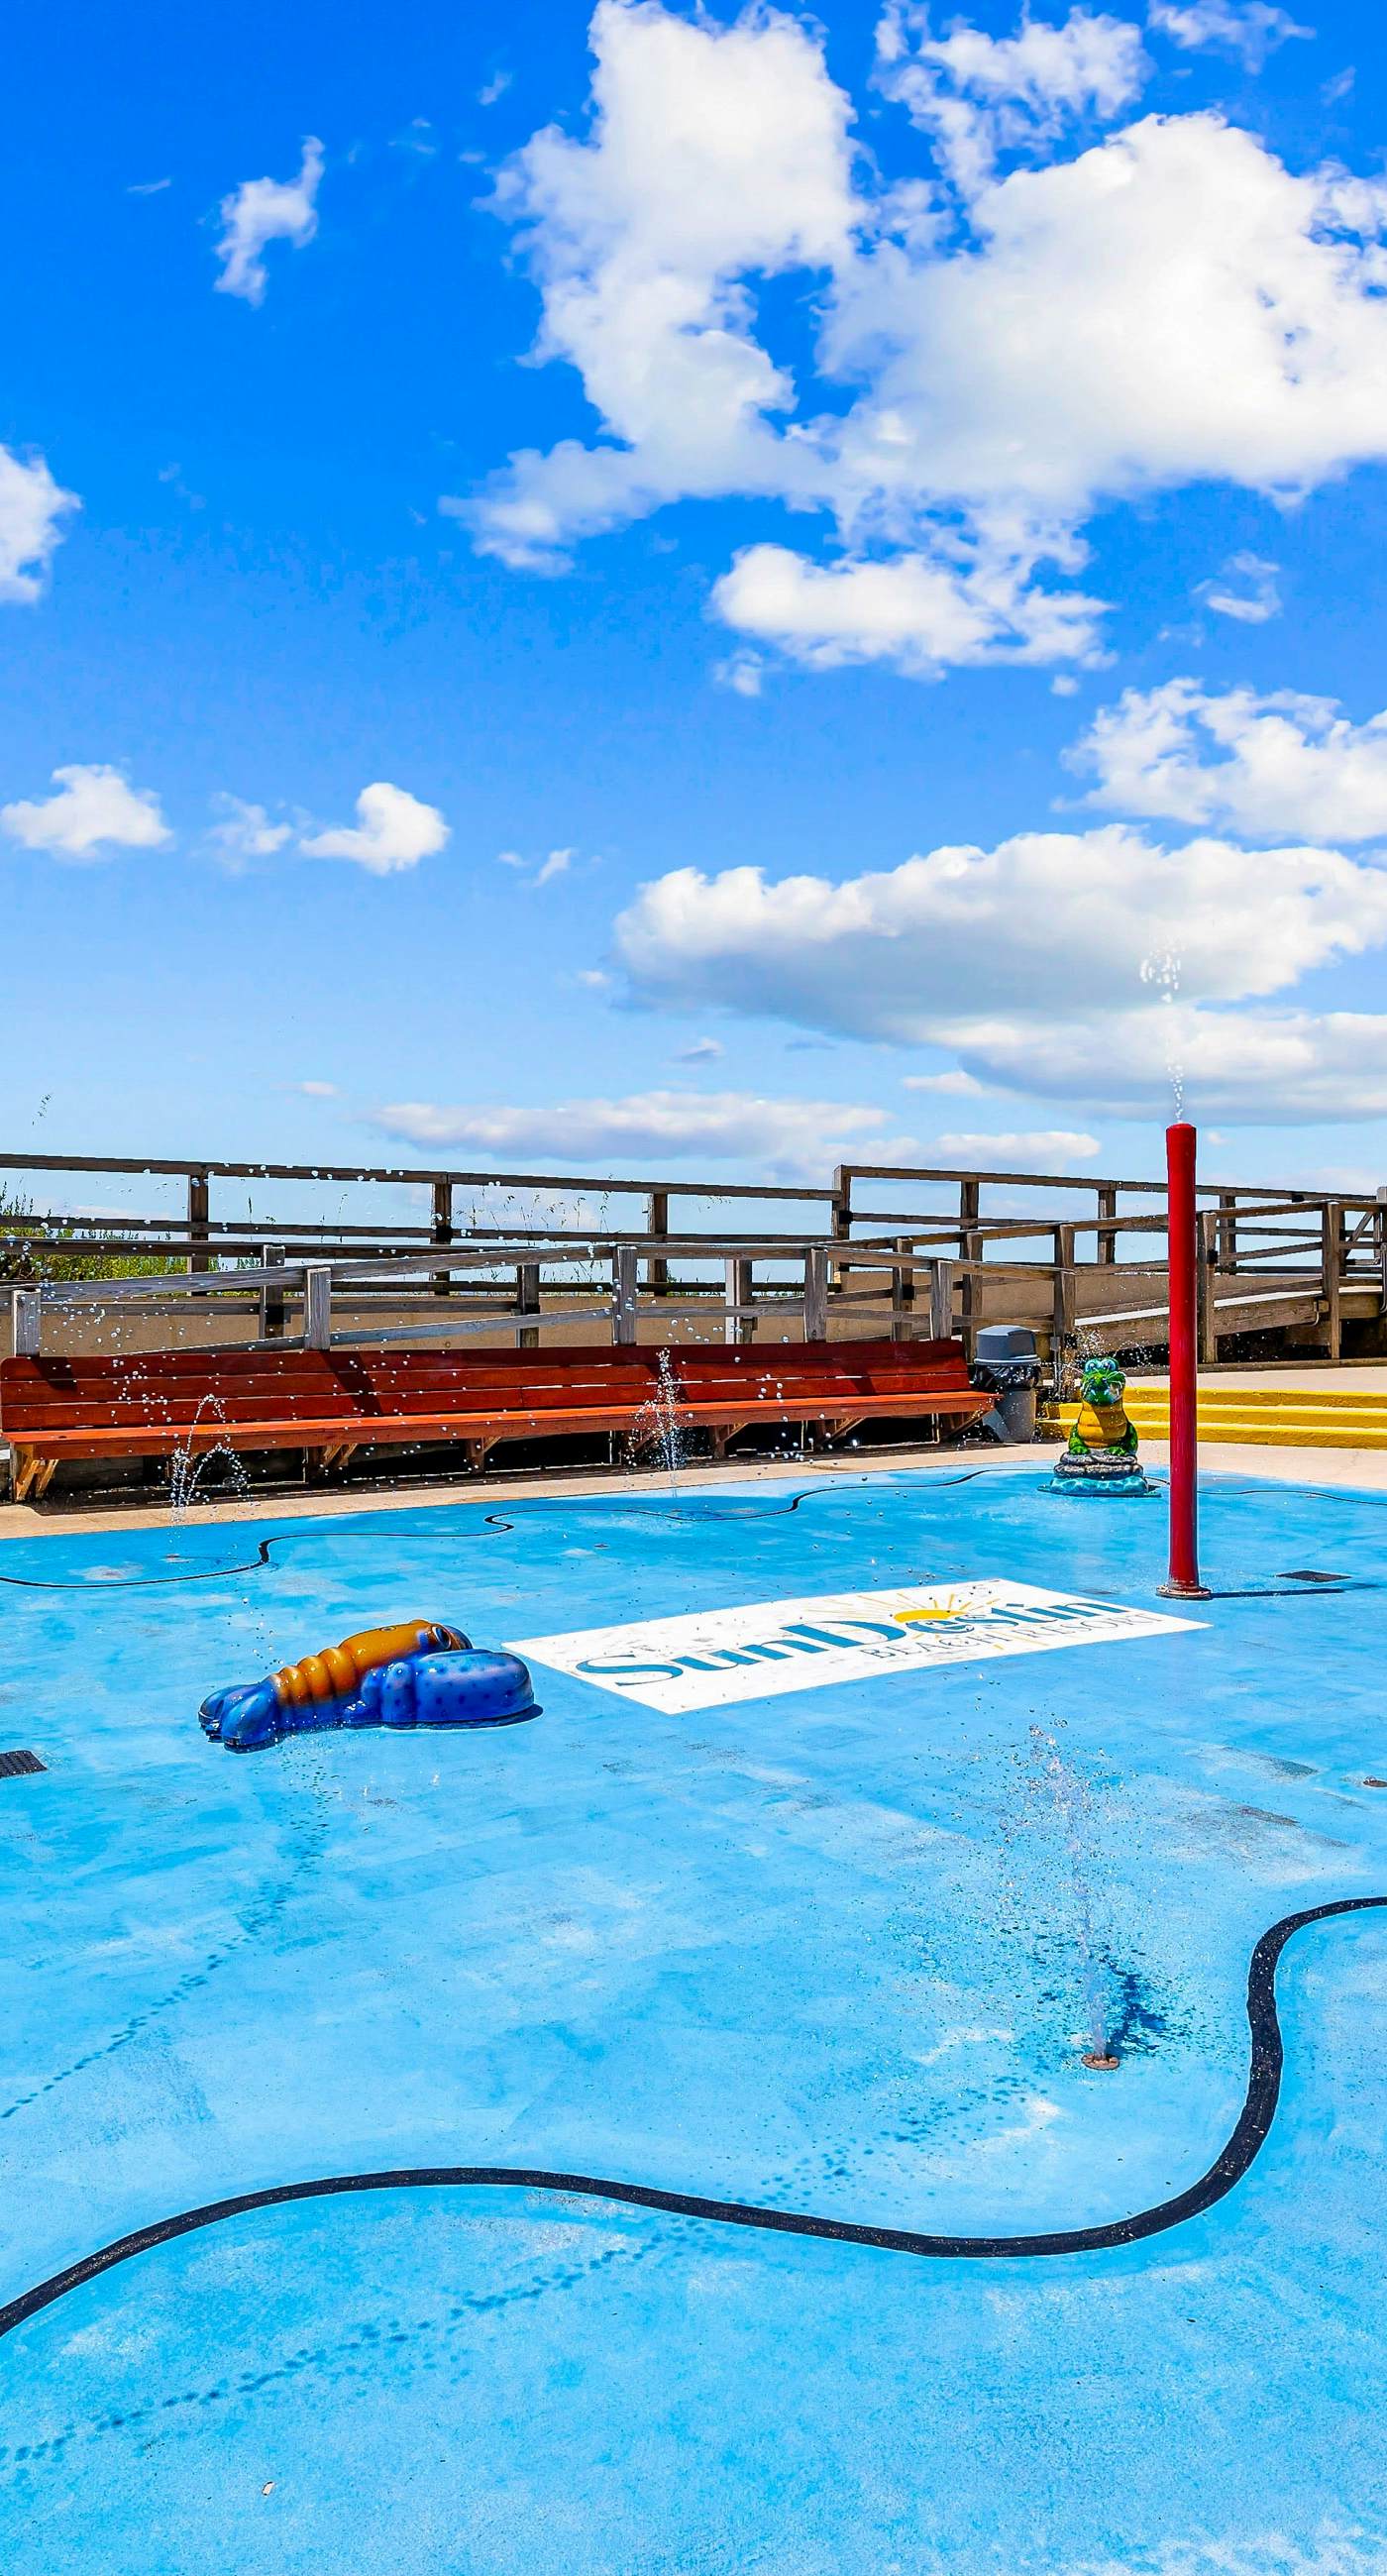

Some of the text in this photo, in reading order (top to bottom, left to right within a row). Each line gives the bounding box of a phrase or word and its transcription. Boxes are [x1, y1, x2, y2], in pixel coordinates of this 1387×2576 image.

[576, 1602, 1129, 1686] SunDestin
[860, 1613, 1163, 1659] BEACH RESORT
